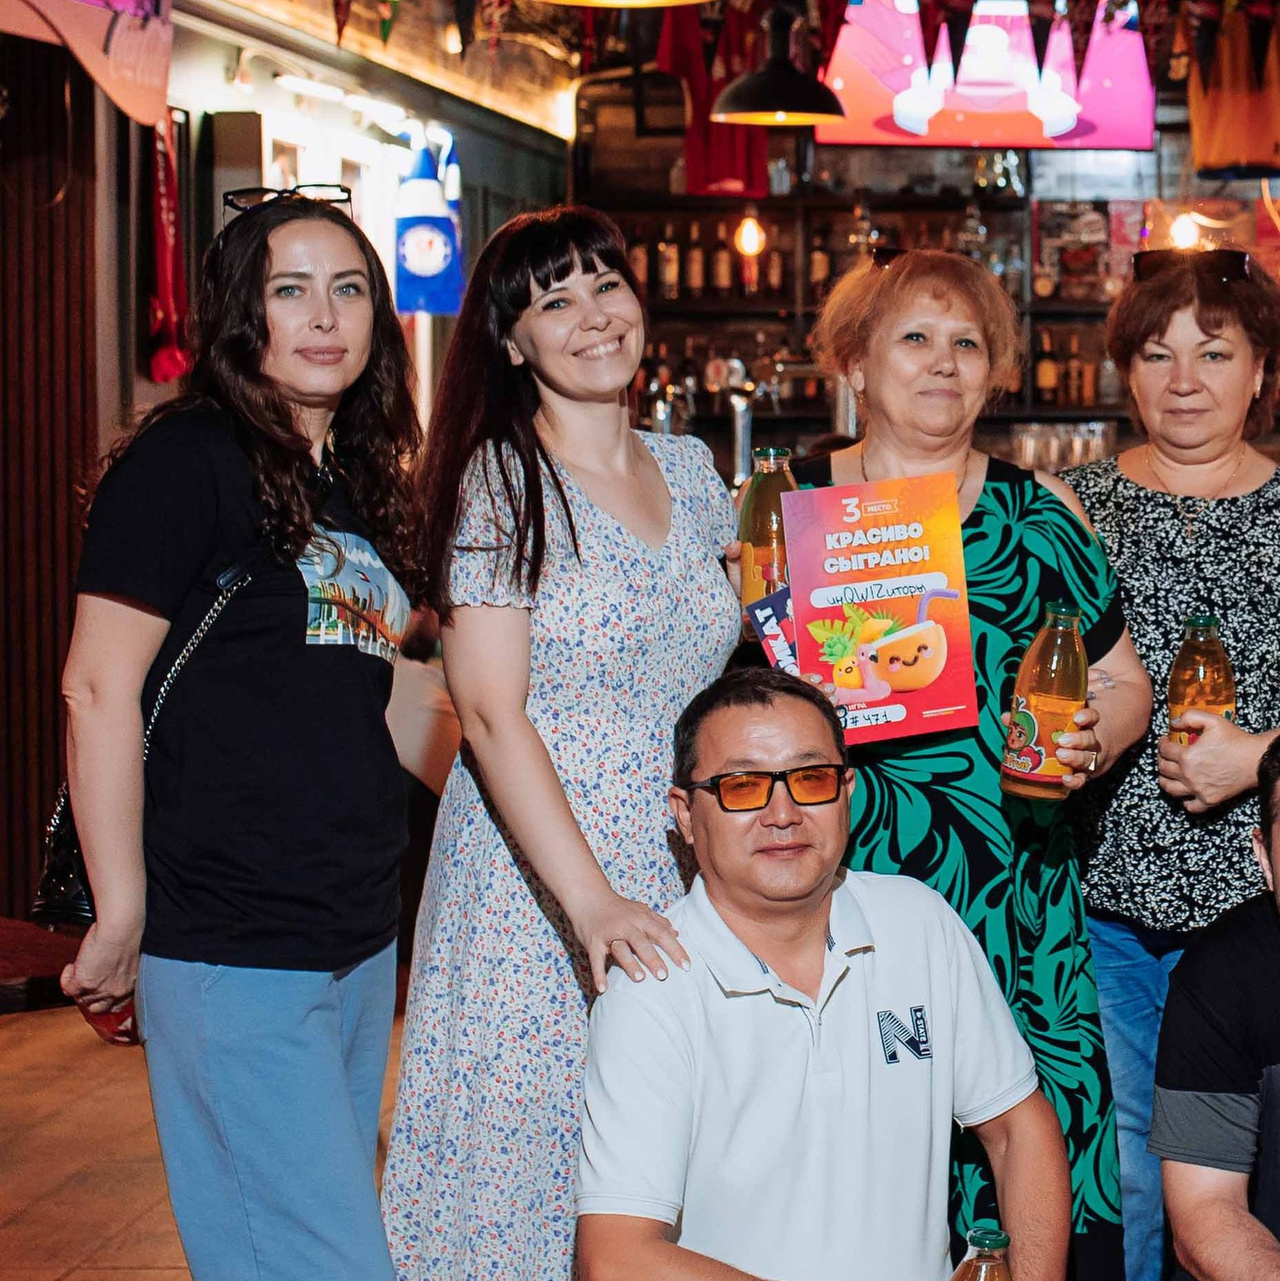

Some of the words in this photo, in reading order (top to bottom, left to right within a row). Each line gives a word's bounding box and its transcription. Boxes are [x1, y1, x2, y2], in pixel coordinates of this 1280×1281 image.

[841, 497, 862, 524] 3
[867, 502, 892, 513] МЕСТО
[824, 522, 924, 551] КРАСИВО
[824, 545, 930, 575] СЫГРАНО!
